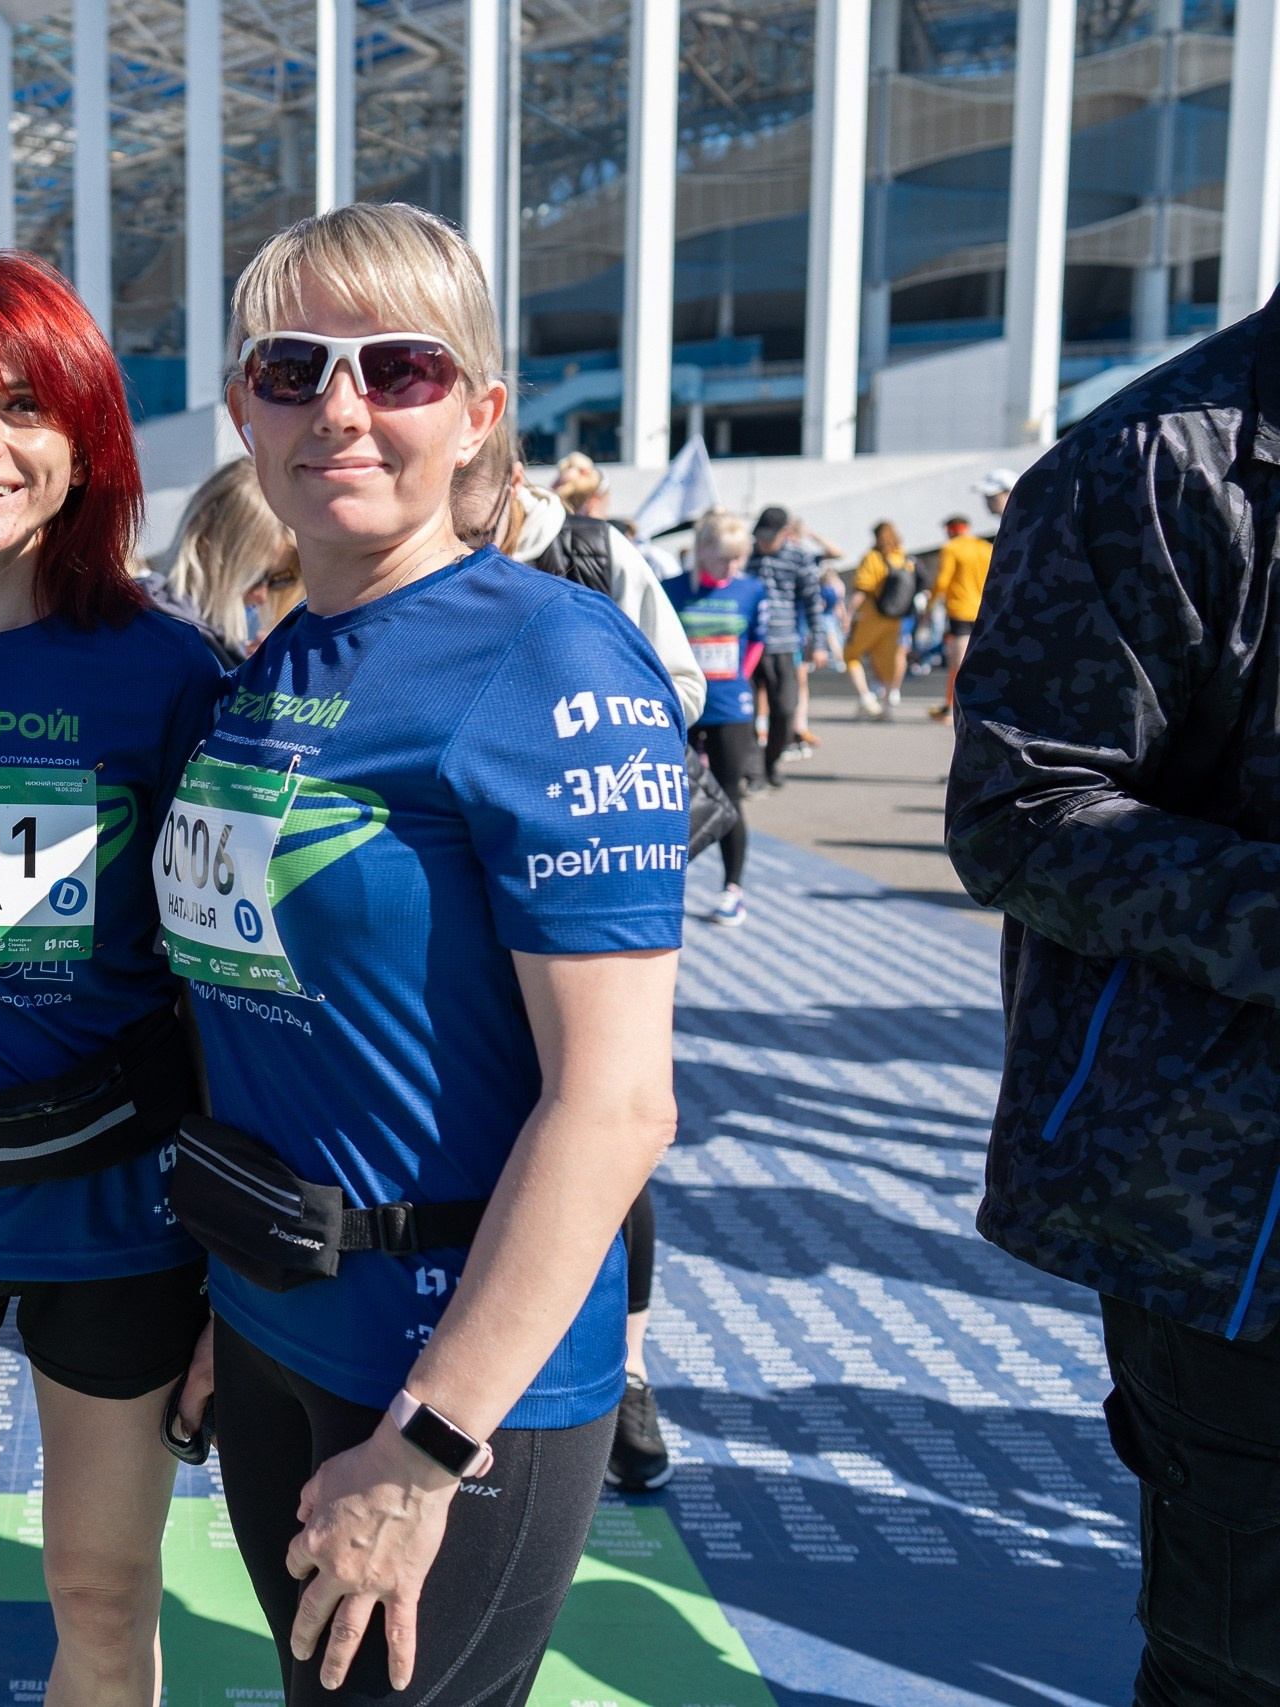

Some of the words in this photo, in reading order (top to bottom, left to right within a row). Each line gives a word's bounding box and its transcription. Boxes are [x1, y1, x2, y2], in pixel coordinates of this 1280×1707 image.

[605, 696, 670, 728] ПСБ
[56, 882, 81, 911] D
[168, 892, 217, 929] НАТАЛЬЯ
[238, 906, 258, 936] D
[58, 939, 80, 949] ПСБ
[34, 993, 72, 1006] 2024
